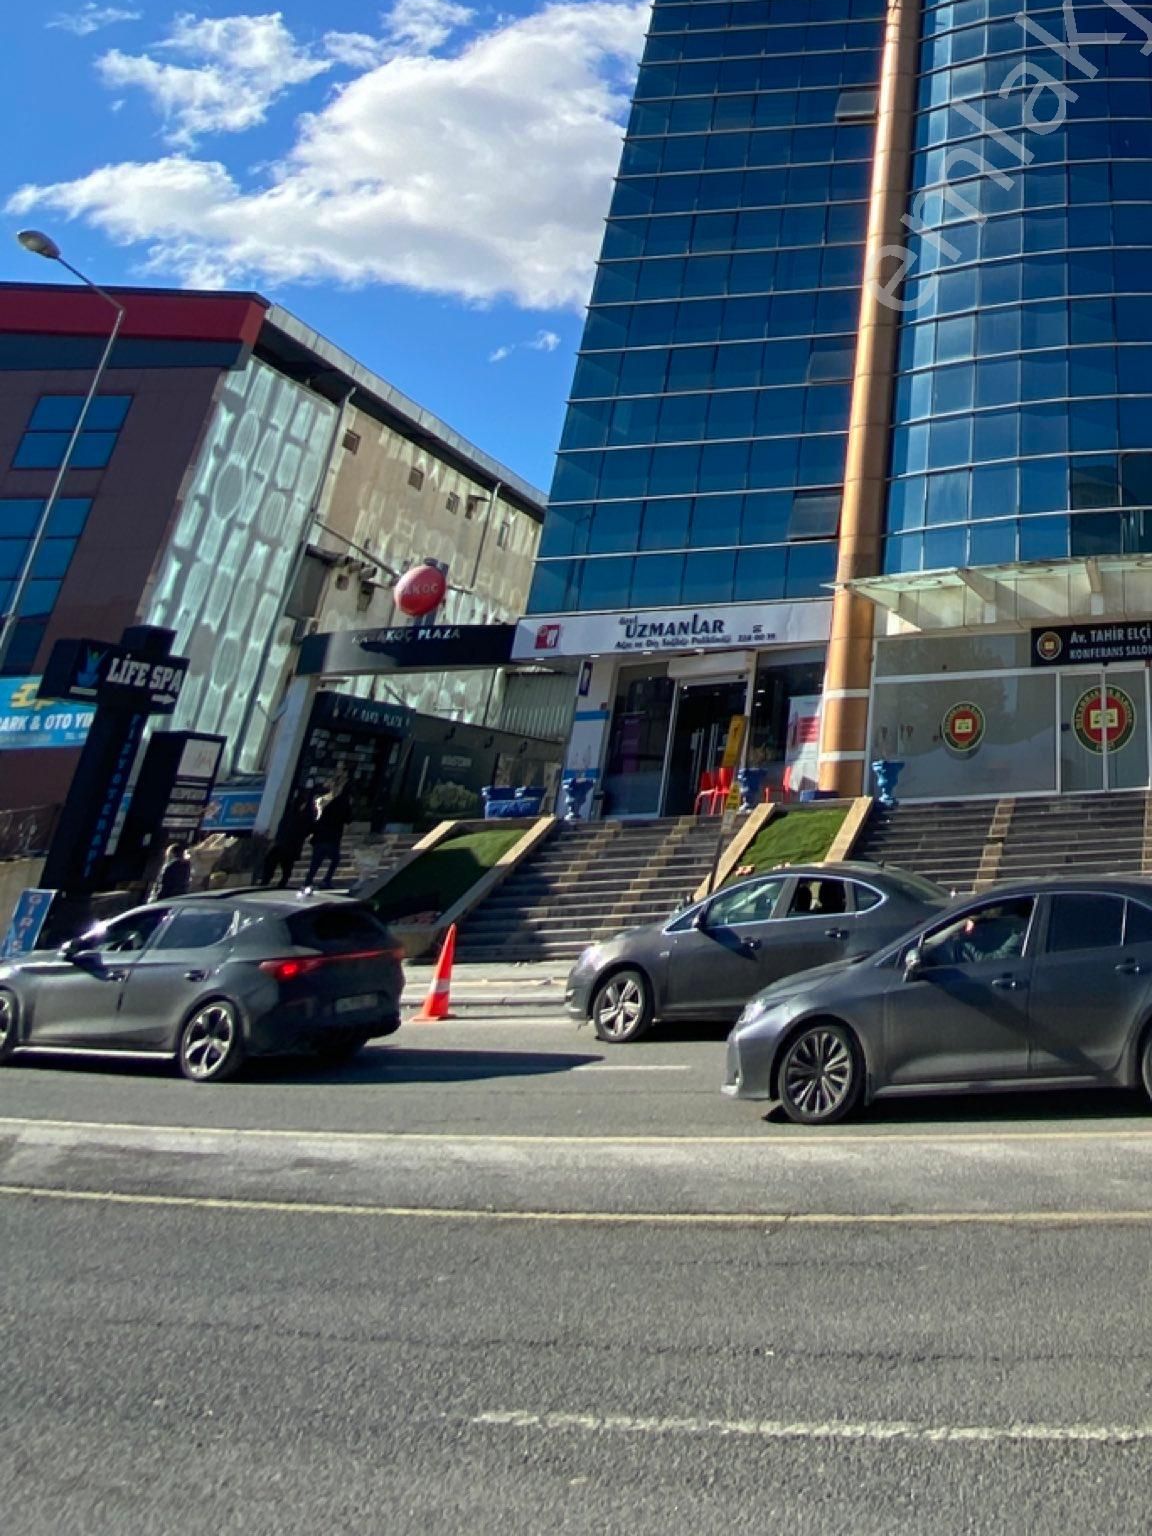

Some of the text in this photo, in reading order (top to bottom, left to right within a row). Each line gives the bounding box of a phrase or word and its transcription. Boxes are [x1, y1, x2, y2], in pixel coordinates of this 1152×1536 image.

[1070, 624, 1151, 644] Av. TAHİR ELÇİ
[1069, 646, 1124, 659] KONFERANS
[106, 653, 184, 693] LİFE SPA
[44, 713, 73, 730] OTO
